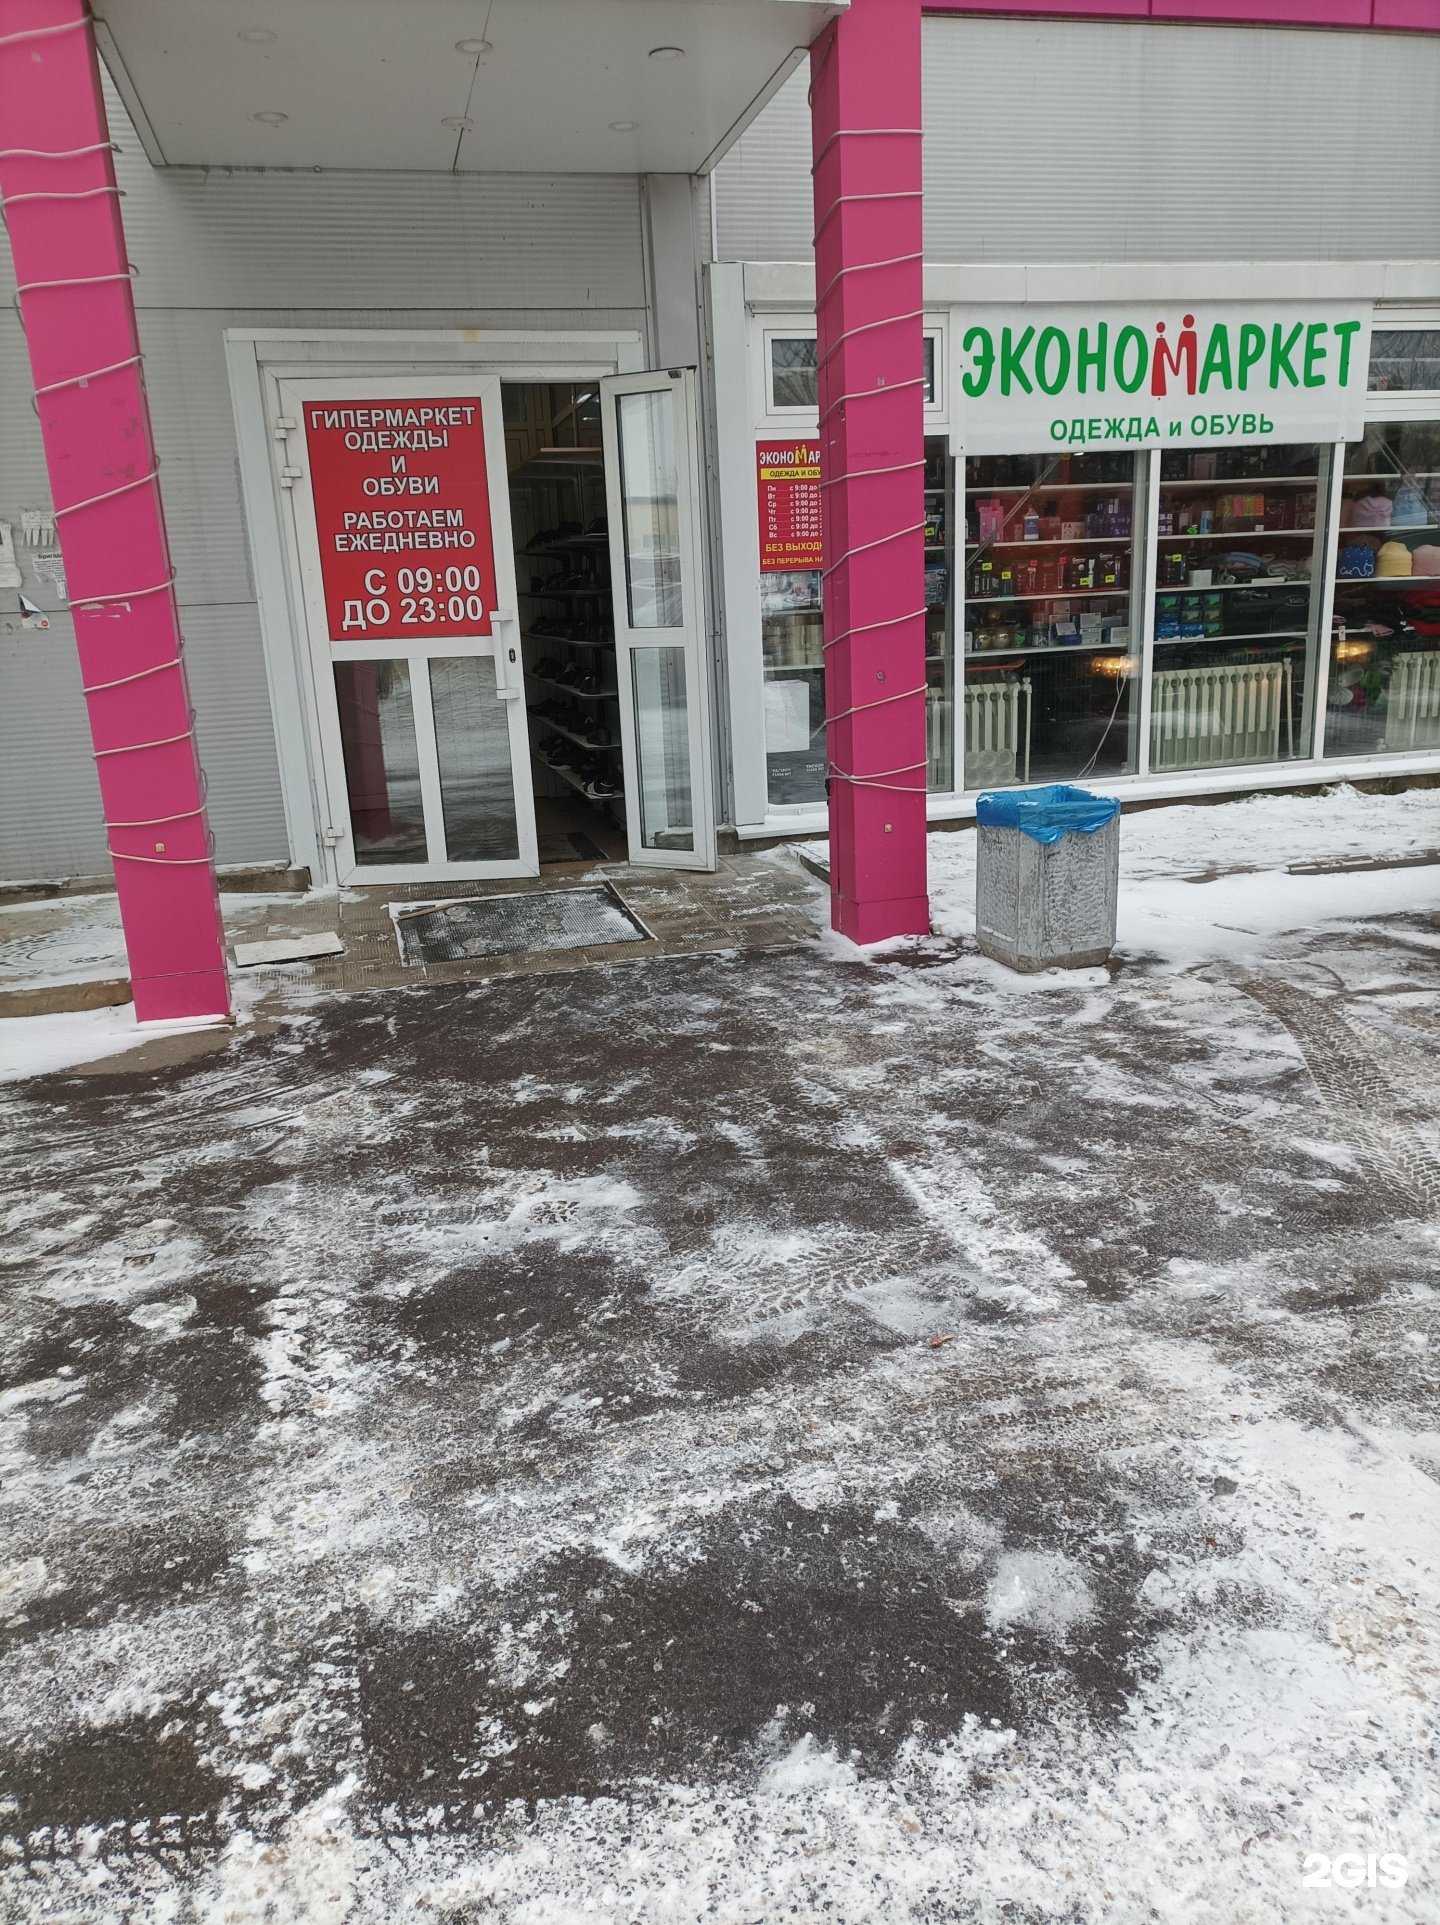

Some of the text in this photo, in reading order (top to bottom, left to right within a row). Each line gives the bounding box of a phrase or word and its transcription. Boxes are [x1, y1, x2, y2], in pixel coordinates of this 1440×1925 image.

[961, 314, 1361, 398] ЭКОНОМАРКЕТ
[311, 406, 476, 429] ГИПЕРМАРКЕТ
[1049, 416, 1161, 444] ОДЕЖДА
[1190, 413, 1275, 437] ОБУВЬ
[344, 429, 449, 452] ОДЕЖДЫ
[391, 455, 407, 474] И
[769, 470, 800, 478] ОДЕЖДА
[362, 476, 440, 496] ОБУВИ
[342, 509, 464, 530] РАБОТАЕМ
[334, 530, 476, 553] ЕЖЕДНЕВНО
[765, 543, 784, 552] БЕЗ
[397, 565, 481, 594] 09:00
[342, 595, 484, 631] ДО 23:00
